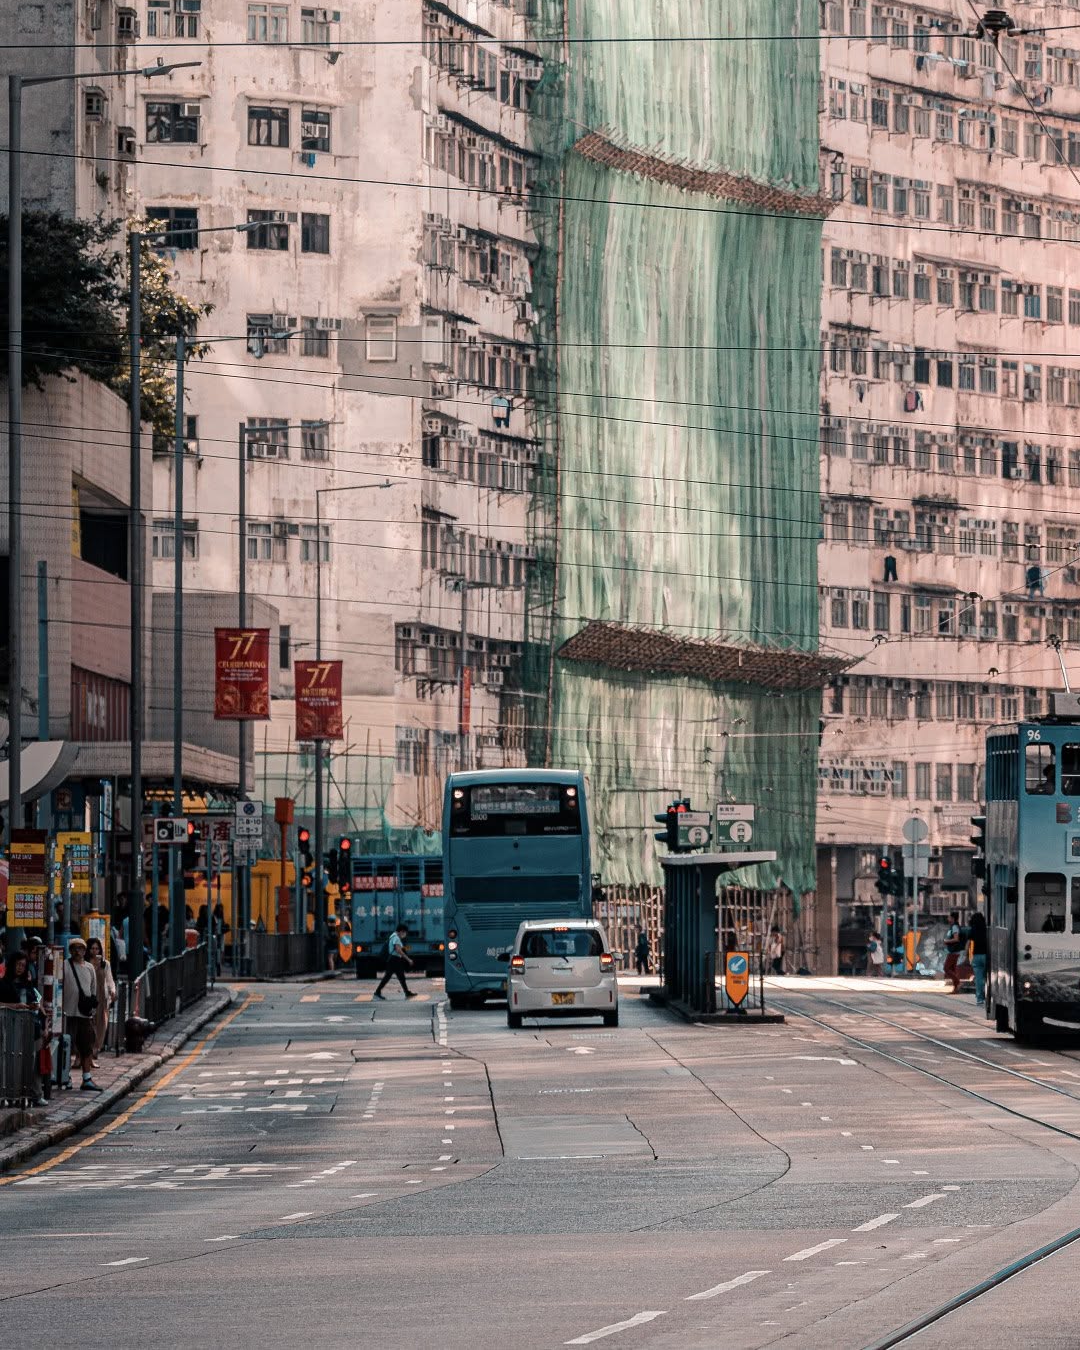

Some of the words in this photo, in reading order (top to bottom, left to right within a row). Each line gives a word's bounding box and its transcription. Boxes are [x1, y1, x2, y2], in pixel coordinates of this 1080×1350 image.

[228, 633, 259, 659] 77
[307, 663, 333, 688] 77
[1027, 730, 1041, 741] 96
